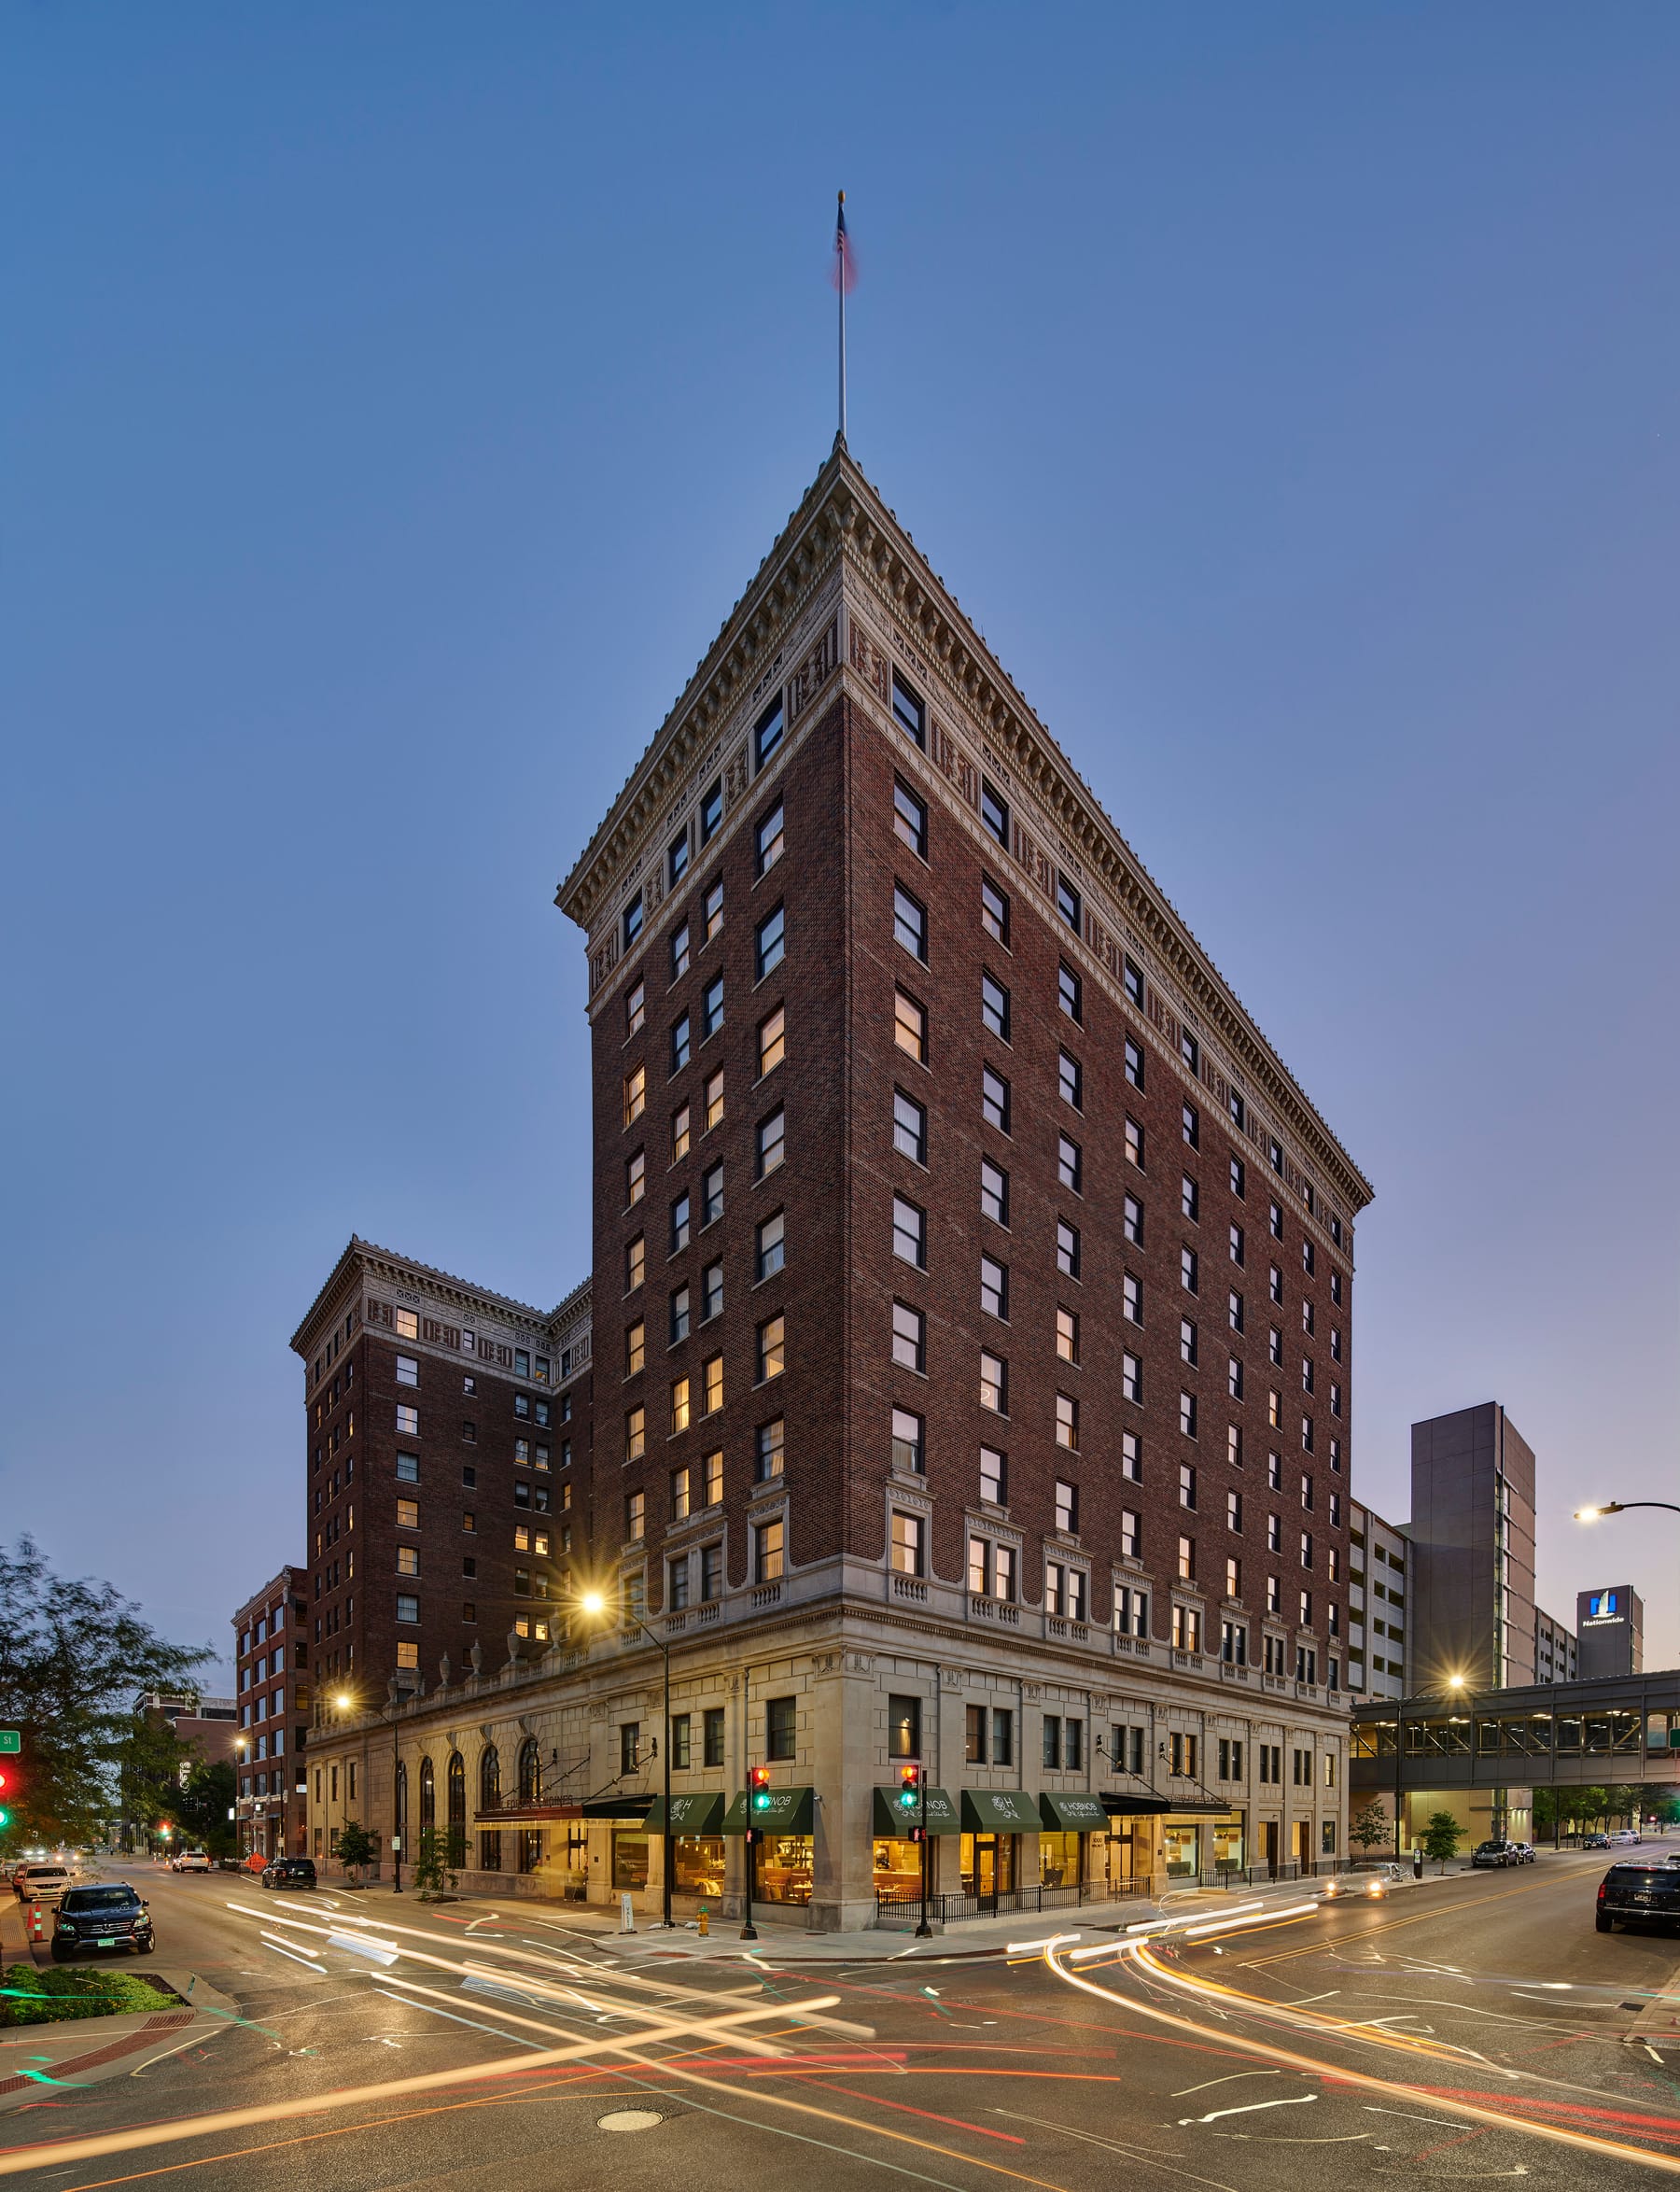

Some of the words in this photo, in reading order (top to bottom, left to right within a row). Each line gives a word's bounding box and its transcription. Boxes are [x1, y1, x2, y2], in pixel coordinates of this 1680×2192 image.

[1582, 1616, 1625, 1627] Nationwide
[3, 1735, 12, 1745] St
[1067, 1802, 1098, 1811] HOBNOB
